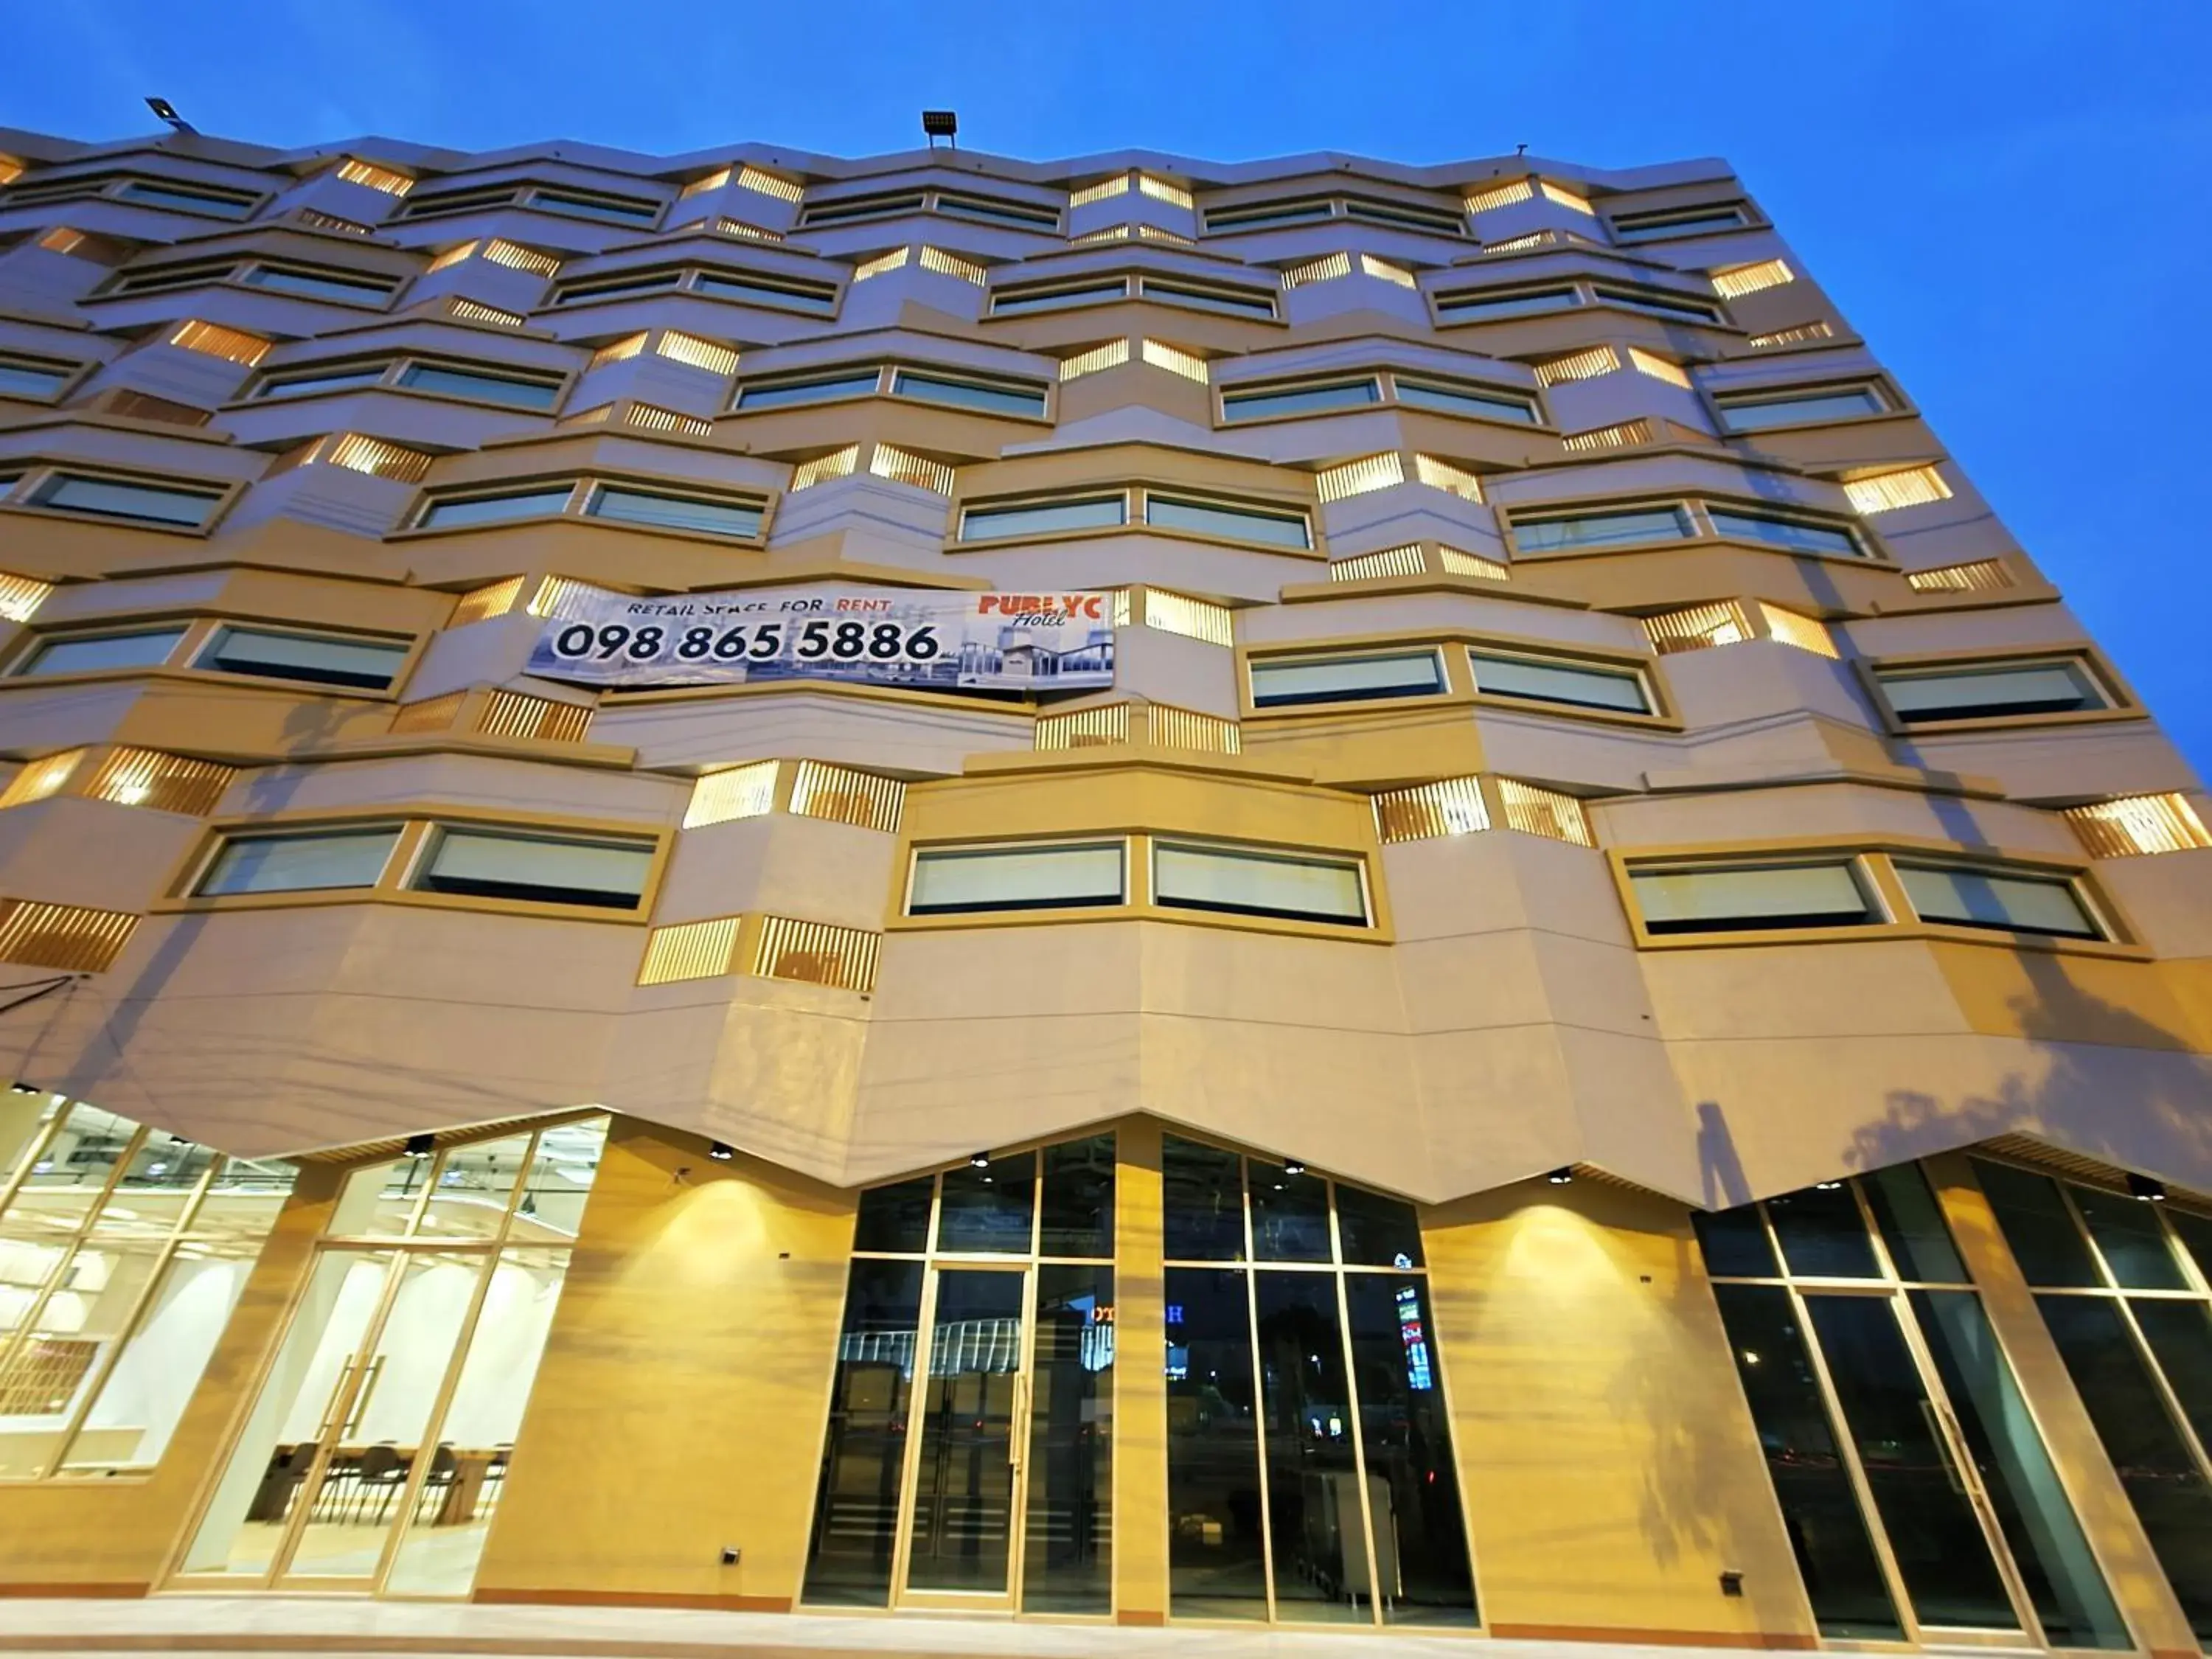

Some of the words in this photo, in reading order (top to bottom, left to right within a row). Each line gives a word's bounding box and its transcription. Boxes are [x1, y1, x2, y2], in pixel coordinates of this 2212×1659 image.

[627, 604, 695, 615] RETAIL
[779, 599, 823, 612] FOR
[837, 599, 891, 611] RENT
[1012, 610, 1068, 627] Hotel
[557, 625, 664, 659] 098
[678, 625, 781, 658] 865
[797, 622, 939, 660] 5886
